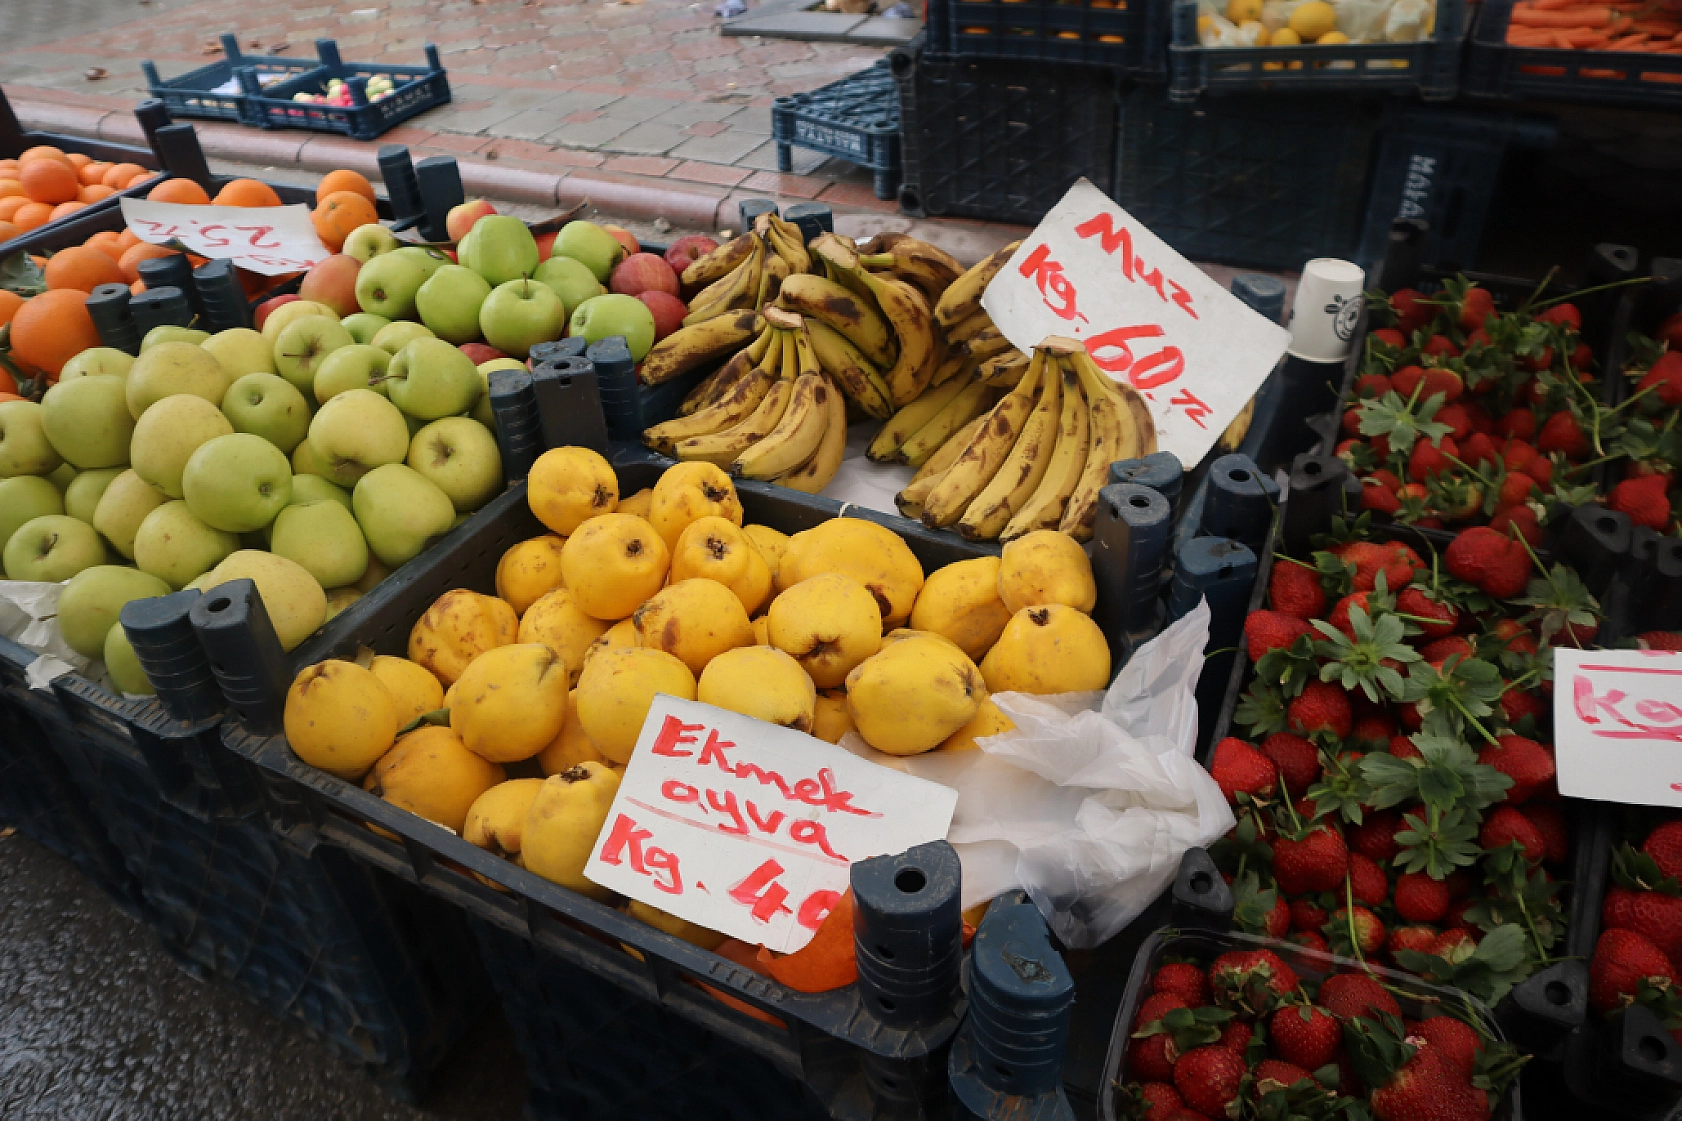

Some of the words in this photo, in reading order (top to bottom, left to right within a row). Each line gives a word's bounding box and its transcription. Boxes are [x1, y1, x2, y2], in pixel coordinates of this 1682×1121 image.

[1399, 154, 1437, 218] MALA
[1018, 243, 1090, 332] Kg.
[1073, 212, 1199, 321] Muz
[651, 714, 884, 819] Ekmek
[661, 779, 850, 862] ayva
